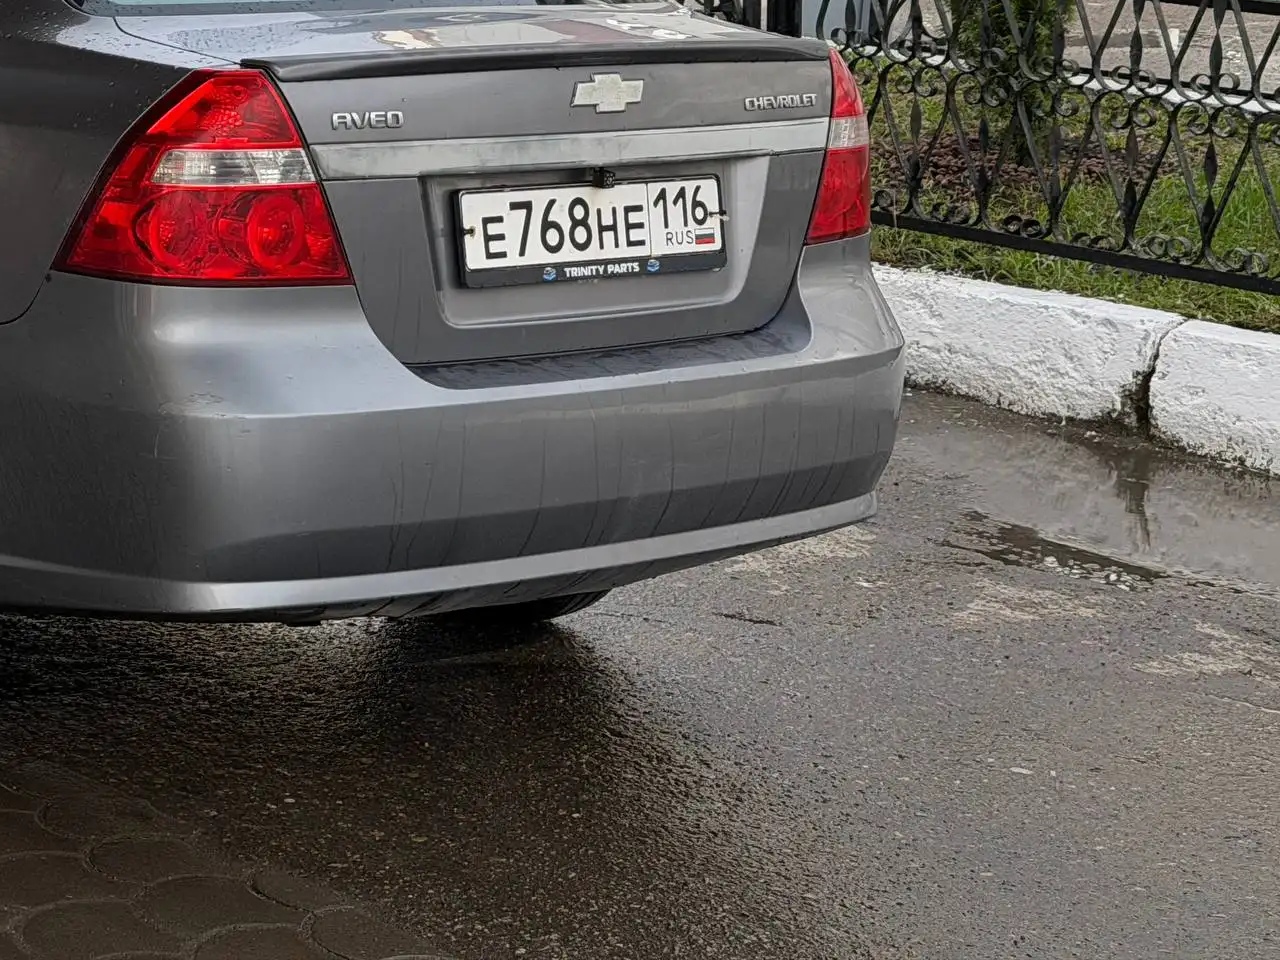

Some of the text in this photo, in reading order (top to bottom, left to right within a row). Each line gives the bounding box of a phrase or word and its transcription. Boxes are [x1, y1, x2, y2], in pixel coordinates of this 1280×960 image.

[744, 93, 818, 111] CHEVROLET
[331, 110, 405, 131] AVEO
[481, 184, 709, 261] Е768НЕ 116
[665, 230, 694, 247] RUS
[563, 261, 640, 278] TRINITY PARTS
